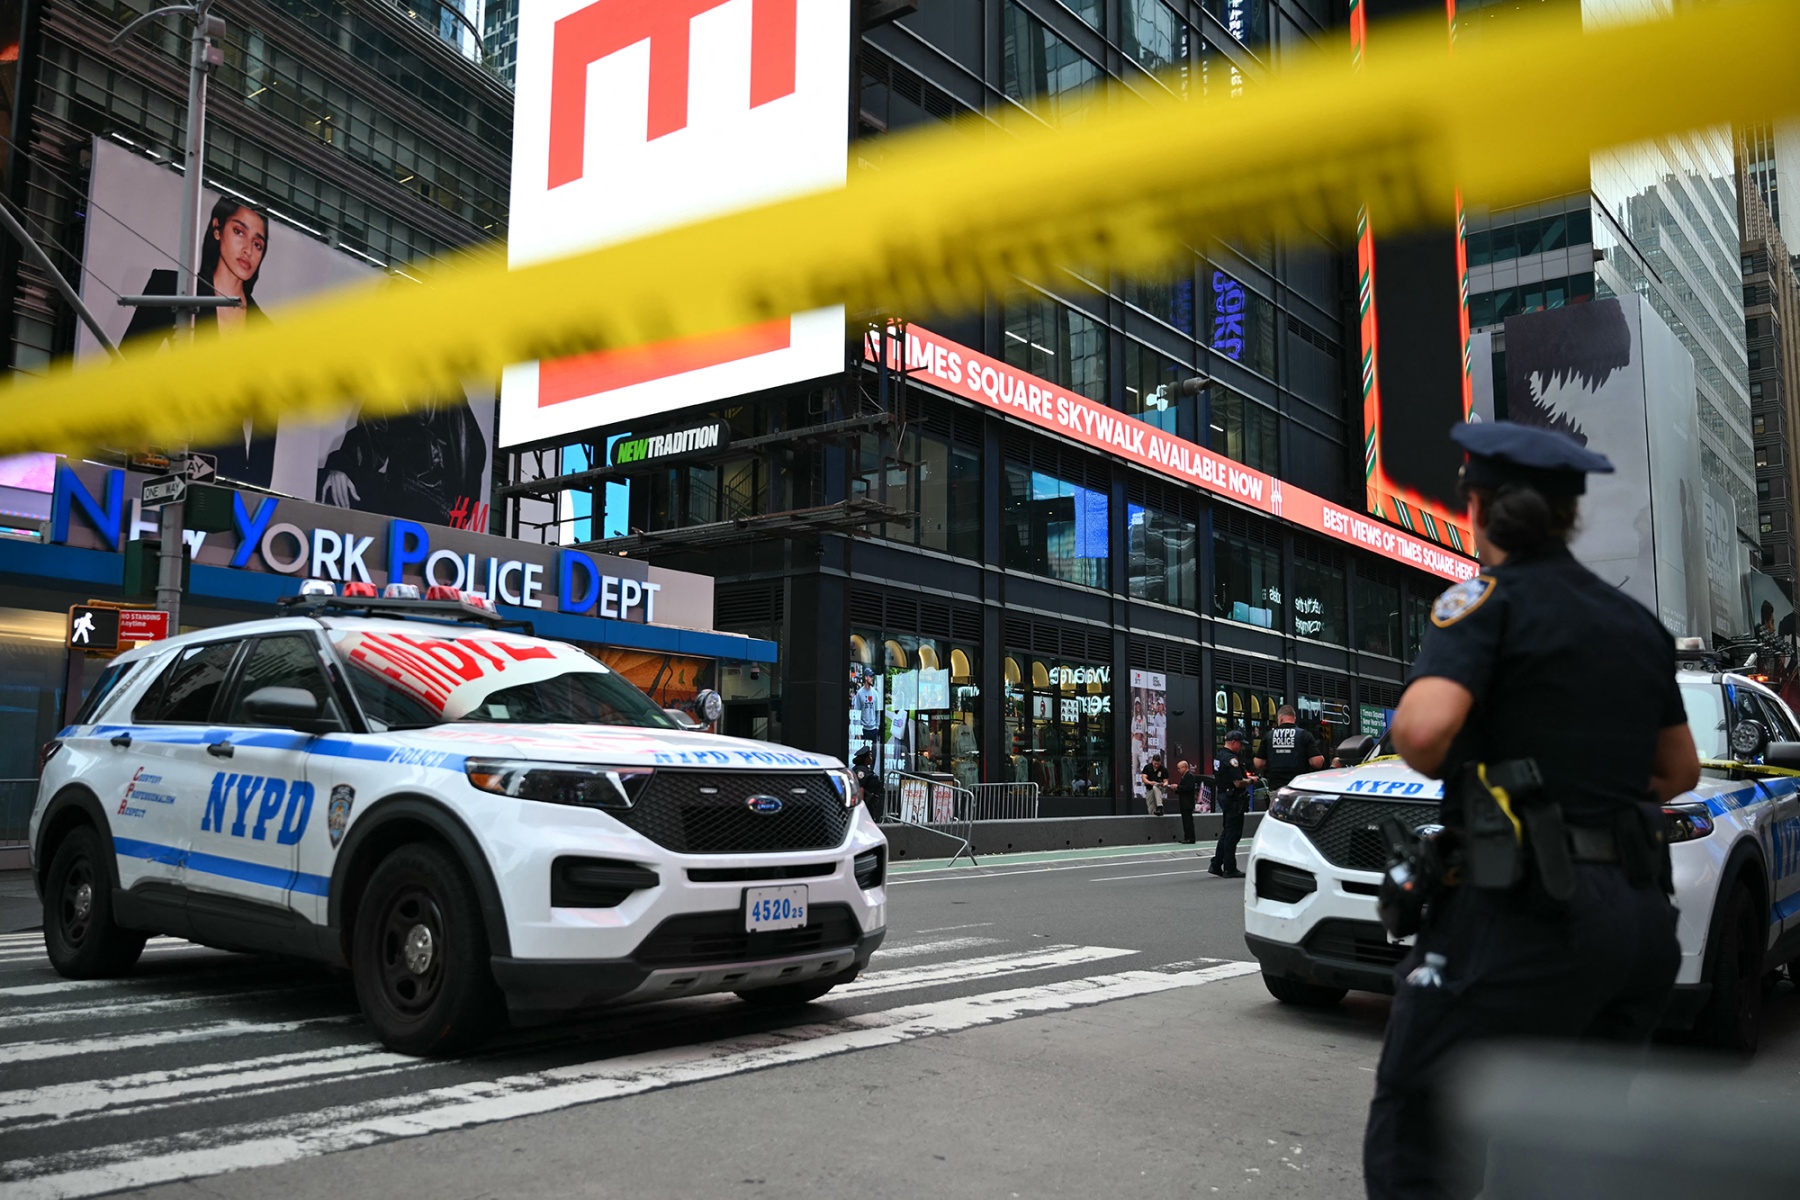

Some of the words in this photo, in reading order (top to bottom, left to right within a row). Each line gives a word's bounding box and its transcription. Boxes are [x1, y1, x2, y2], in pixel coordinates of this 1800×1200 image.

[967, 360, 1053, 421] SQUARE
[1057, 397, 1145, 457] SKYWALK
[1148, 434, 1226, 489] AVAILABLE
[1229, 467, 1263, 502] NOW
[187, 461, 204, 473] AY
[145, 487, 159, 498] ONE
[165, 482, 180, 494] WAY
[1323, 506, 1350, 536] BEST
[1350, 518, 1382, 548] VIEWS
[1383, 530, 1396, 552] OF
[1396, 536, 1422, 564] TIMES
[1423, 548, 1455, 577] SQUARE
[1455, 561, 1473, 580] HERE
[229, 489, 375, 583] YORK
[388, 518, 544, 609] POLICE
[559, 548, 661, 624] DEPT
[131, 613, 161, 621] STANDING
[1272, 737, 1295, 746] POLICE
[1273, 728, 1296, 738] NYPD
[389, 747, 447, 767] POLICE
[655, 750, 730, 764] NYPD
[733, 751, 820, 767] POLICE
[1346, 778, 1424, 796] NYPD
[201, 771, 315, 846] NYPD
[752, 898, 791, 922] 4520
[792, 906, 803, 918] 25
